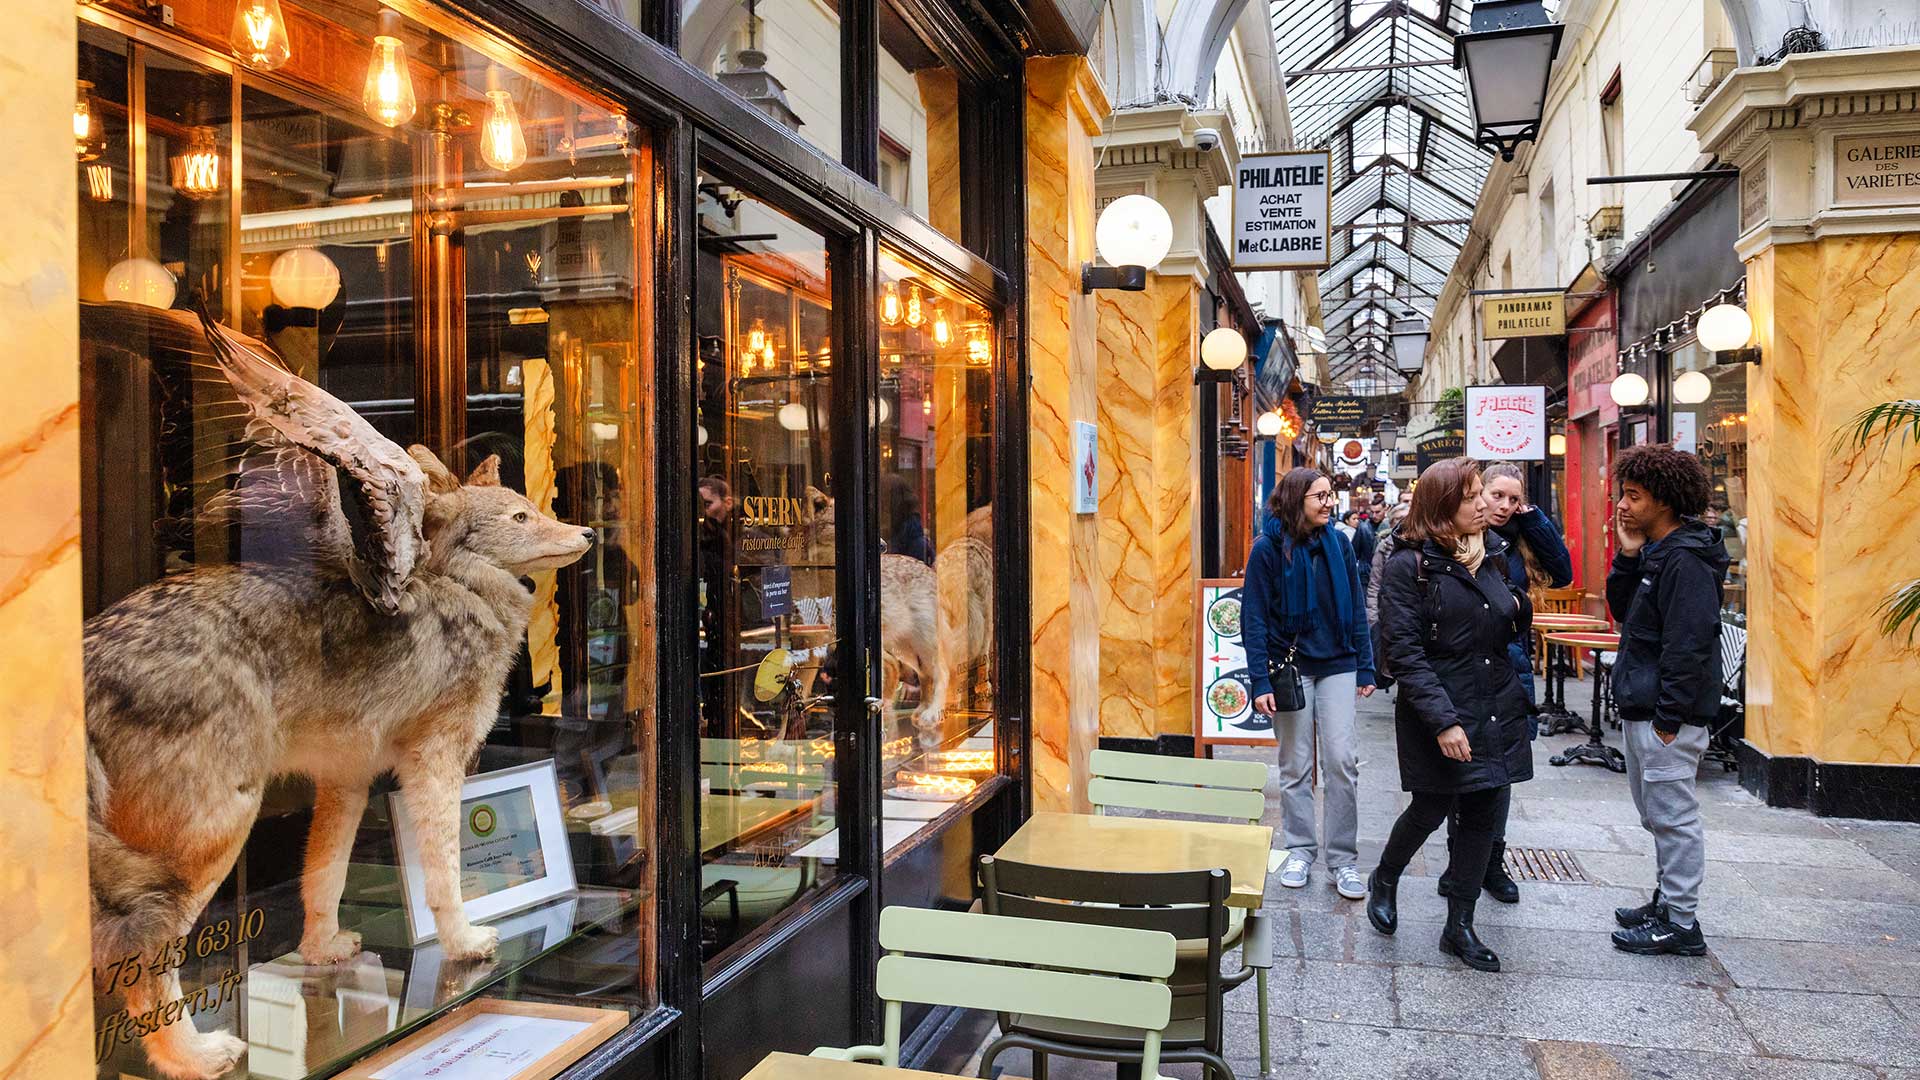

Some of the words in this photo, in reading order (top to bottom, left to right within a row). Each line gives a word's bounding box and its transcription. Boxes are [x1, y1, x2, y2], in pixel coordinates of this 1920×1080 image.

[1847, 145, 1920, 162] GALERIE
[1876, 162, 1899, 171] DES
[1259, 193, 1302, 205] ACHAT
[1259, 207, 1302, 218] VENTE
[1245, 219, 1316, 231] ESTIMATION
[1498, 301, 1552, 313] PANORAMAS
[1498, 316, 1551, 330] PHILATELIE
[743, 496, 802, 526] STERN
[741, 534, 781, 553] ristorante
[106, 951, 143, 995] 75
[148, 934, 190, 977] 43
[196, 919, 231, 958] 63
[234, 908, 266, 946] 10
[95, 968, 243, 1065] ffestern.fr
